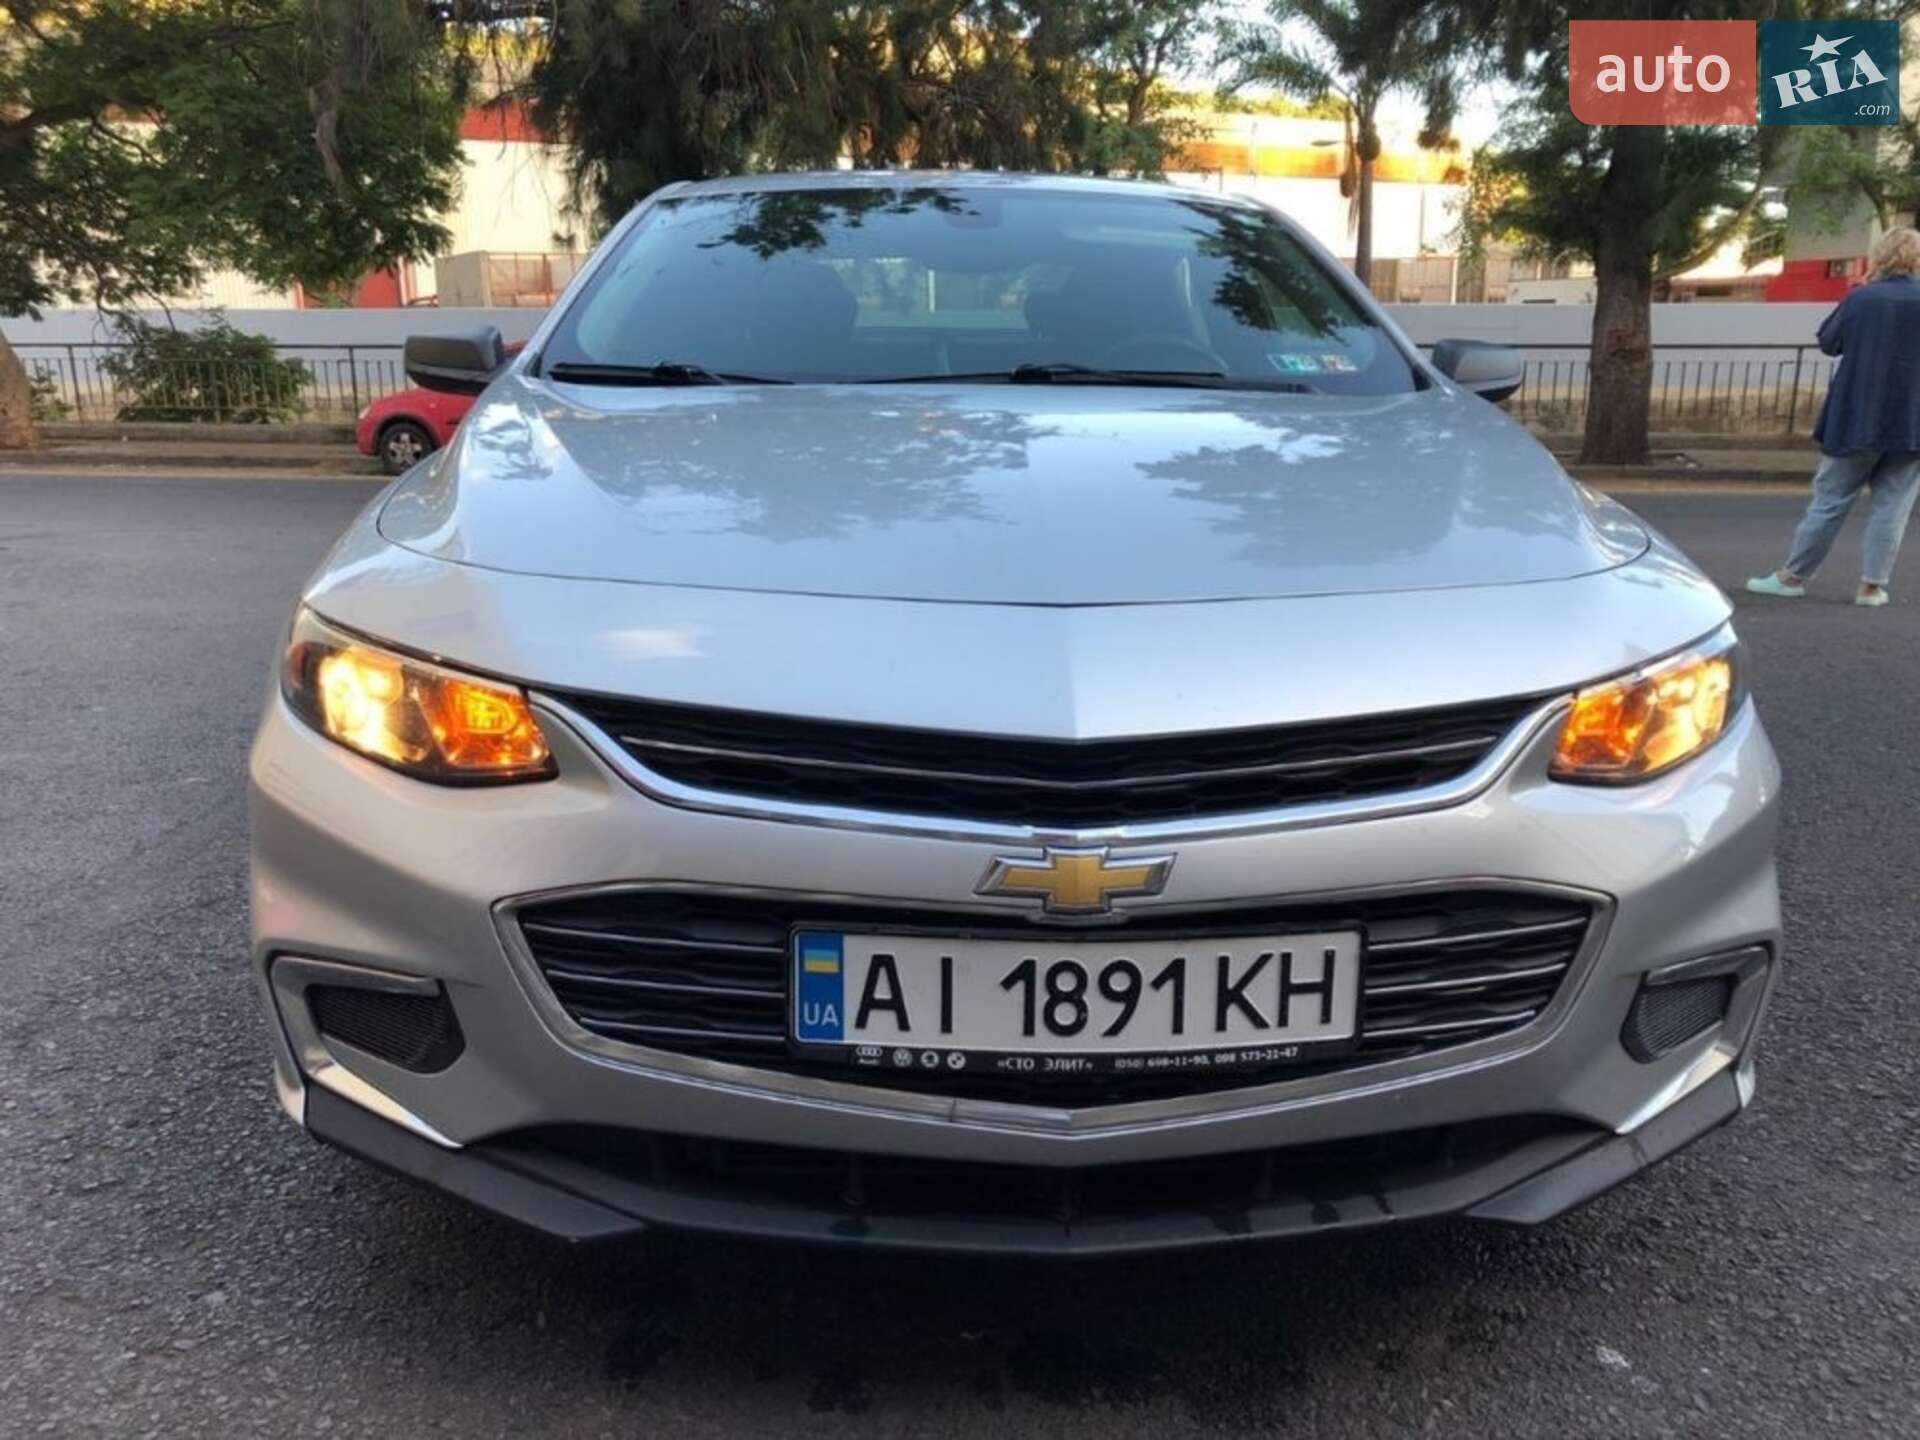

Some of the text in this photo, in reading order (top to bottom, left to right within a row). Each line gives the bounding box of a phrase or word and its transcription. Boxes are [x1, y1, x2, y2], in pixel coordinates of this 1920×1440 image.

[803, 1003, 840, 1027] UA
[854, 949, 1336, 1038] AI 1891 KH
